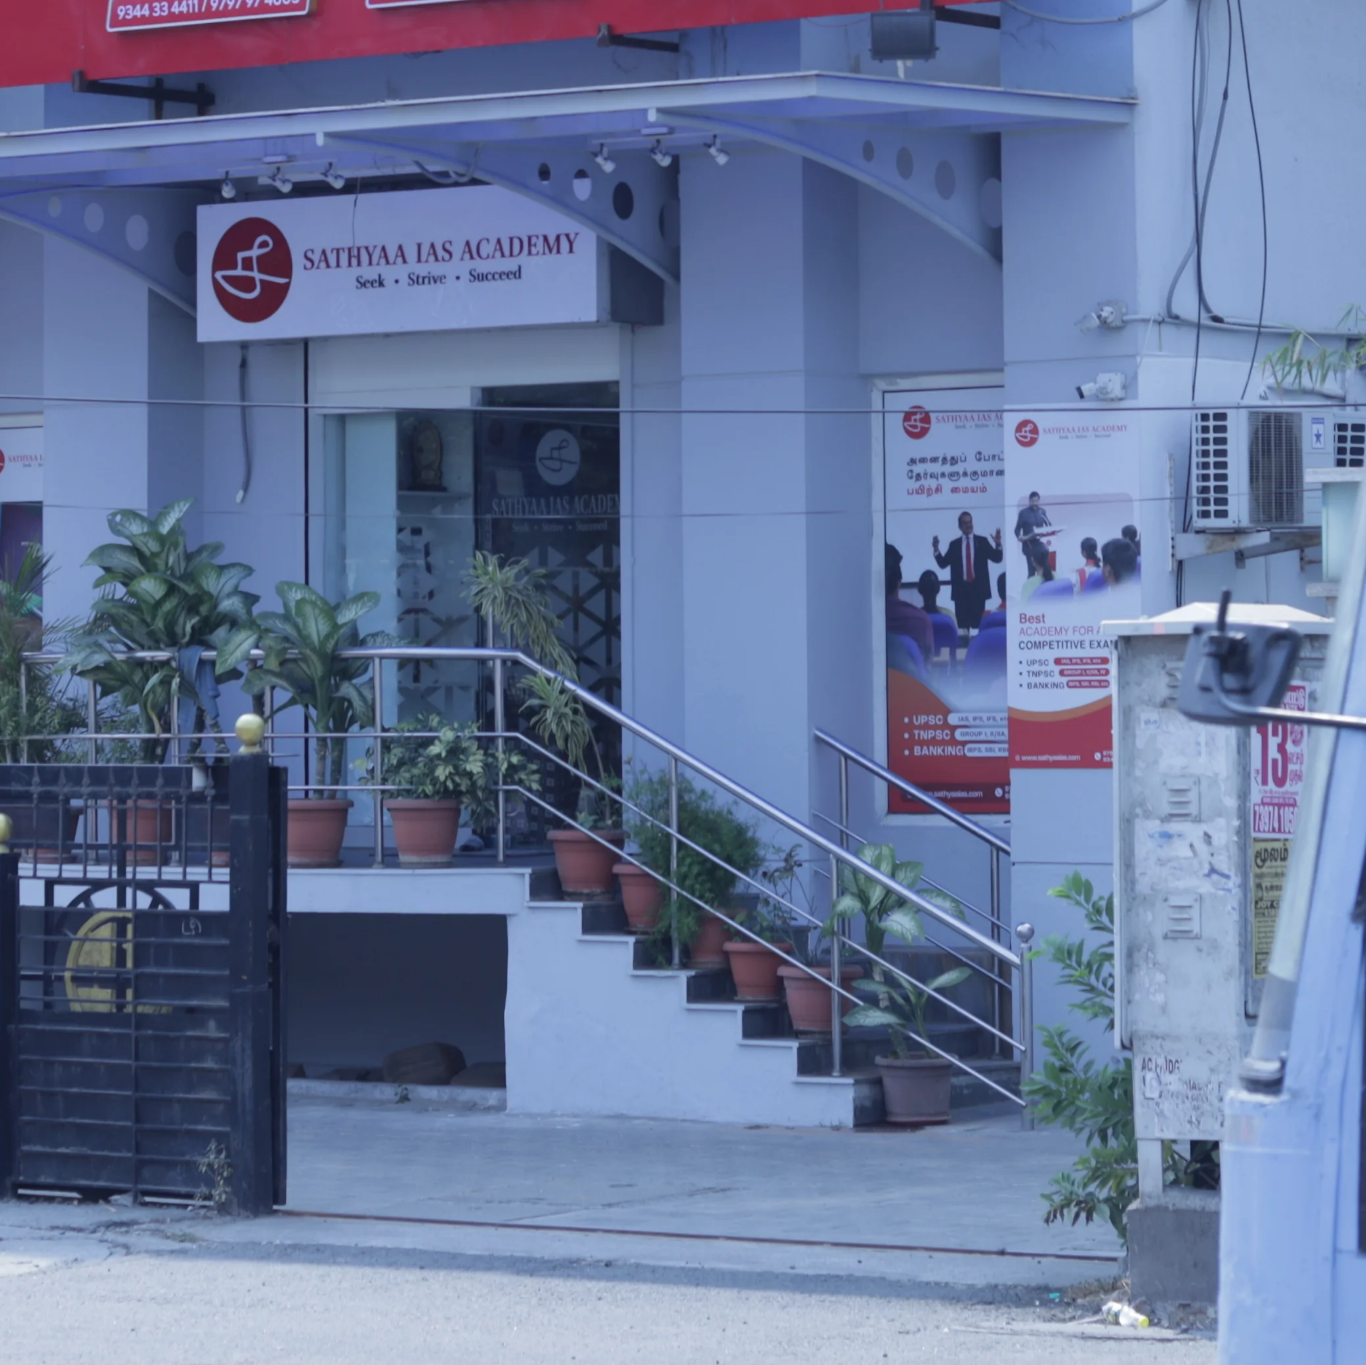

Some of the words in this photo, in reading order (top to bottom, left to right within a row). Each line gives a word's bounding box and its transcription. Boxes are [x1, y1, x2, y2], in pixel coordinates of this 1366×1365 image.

[117, 3, 148, 20] 9344
[152, 1, 167, 16] 33
[303, 243, 408, 271] SATHYAA
[416, 240, 453, 263] IAS
[459, 232, 580, 262] ACADEMY
[355, 274, 386, 290] Seek
[407, 271, 447, 287] Strive
[468, 265, 522, 284] Succeed
[1019, 613, 1046, 624] Best
[1019, 626, 1070, 636] ACADEMY
[1073, 625, 1094, 635] FOR
[1018, 639, 1086, 650] COMPETITIVE
[913, 714, 943, 725] UPSC
[913, 729, 951, 740] TNPSC
[914, 745, 964, 756] BANKING
